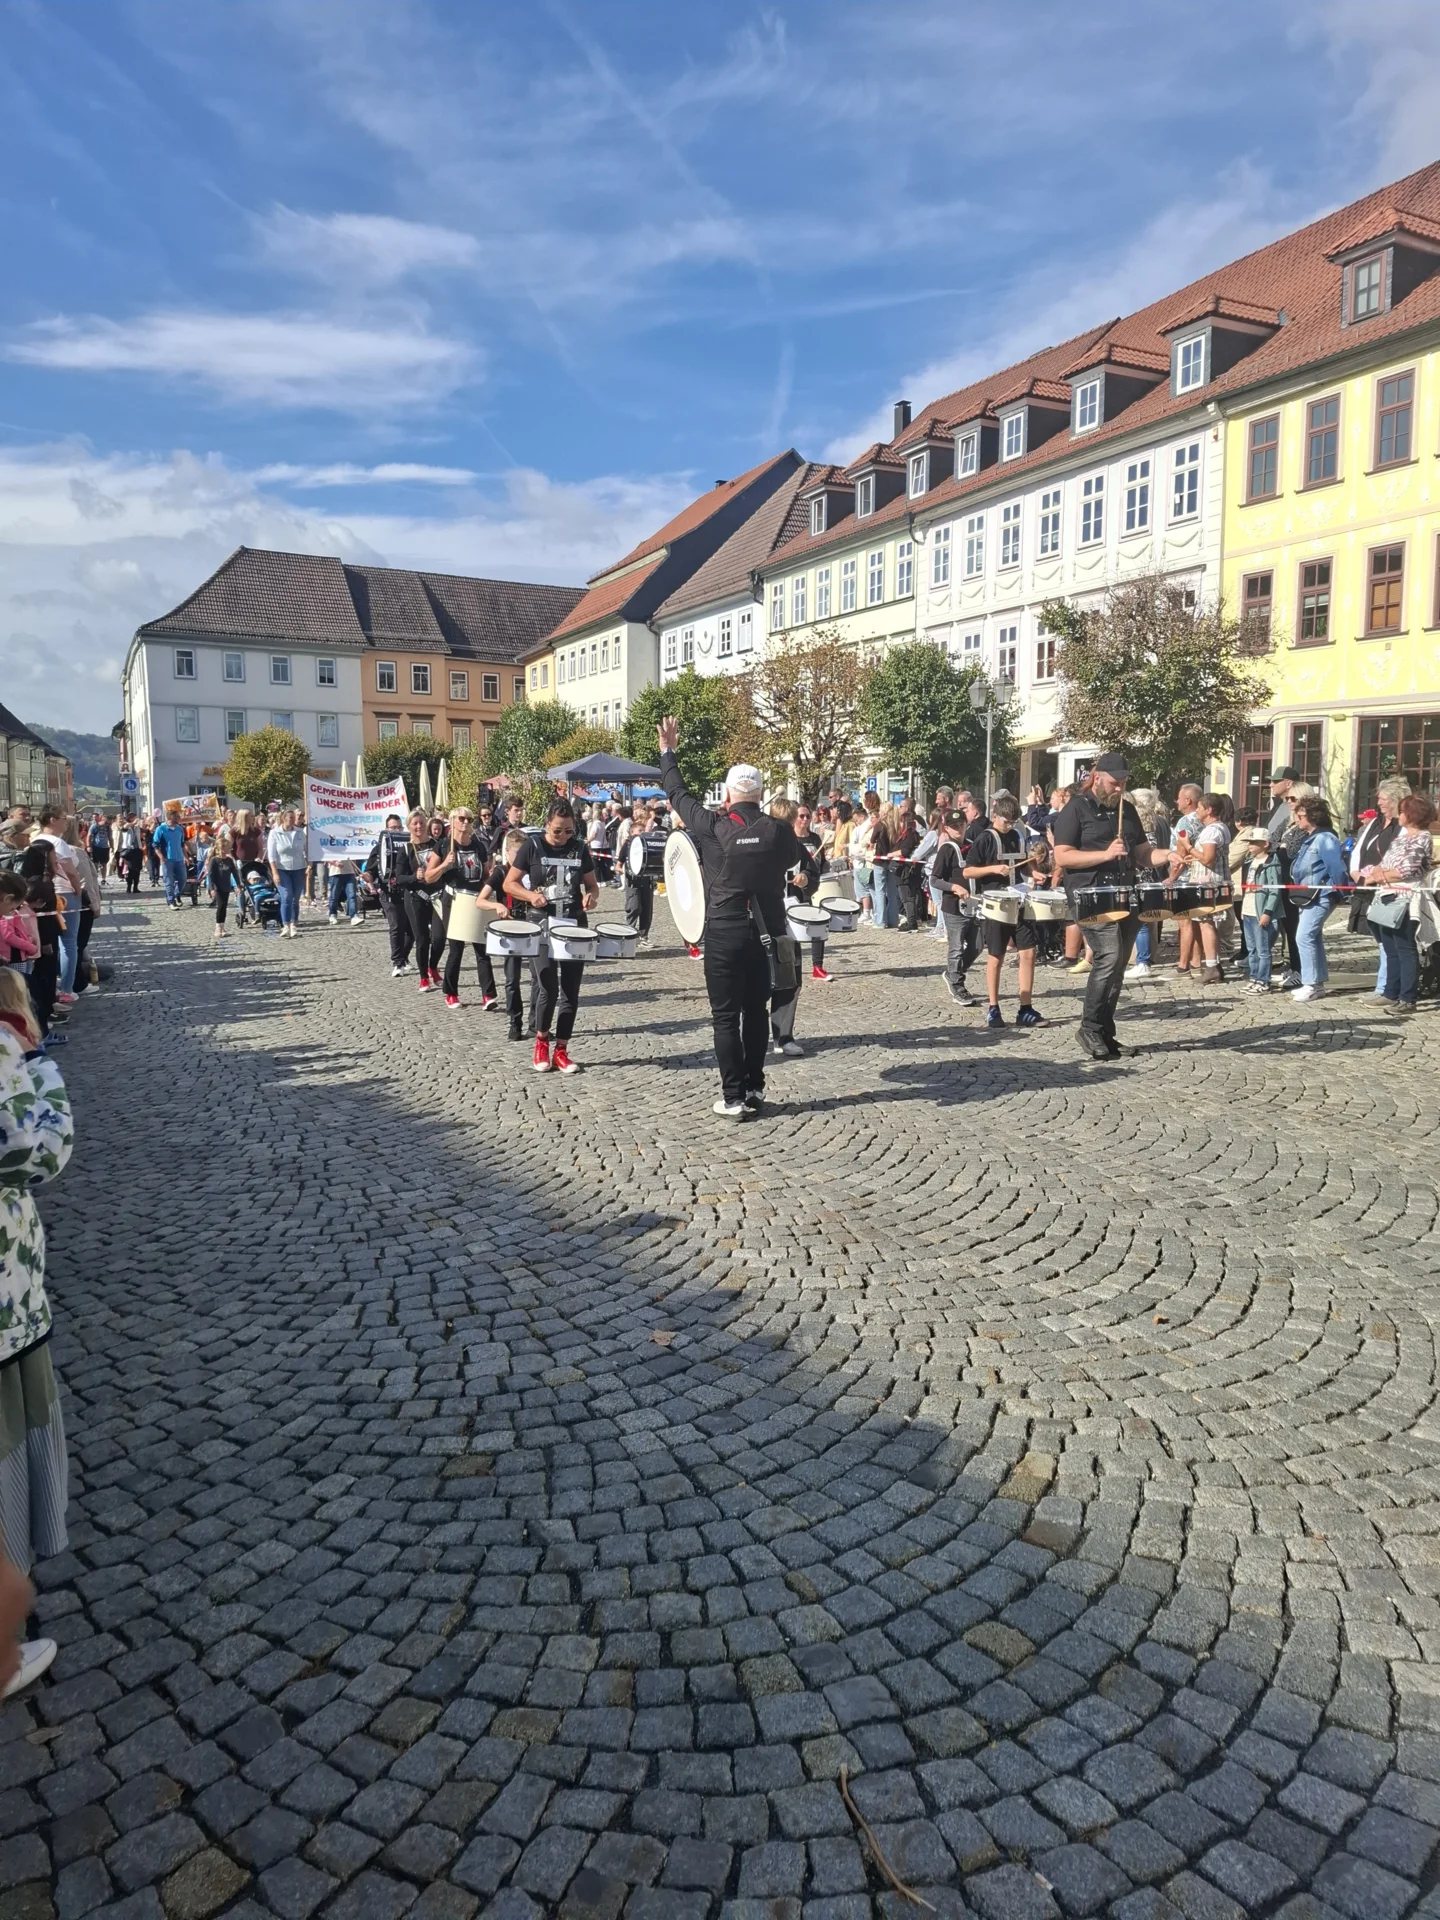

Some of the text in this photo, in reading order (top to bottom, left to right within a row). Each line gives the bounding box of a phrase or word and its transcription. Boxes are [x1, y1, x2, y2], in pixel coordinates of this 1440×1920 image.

[310, 784, 396, 800] GEMEINSAM FÜR
[316, 795, 406, 811] UNSERE KINDER!
[308, 815, 383, 831] FÖRDERVEREIN
[320, 838, 379, 847] WERRASPA
